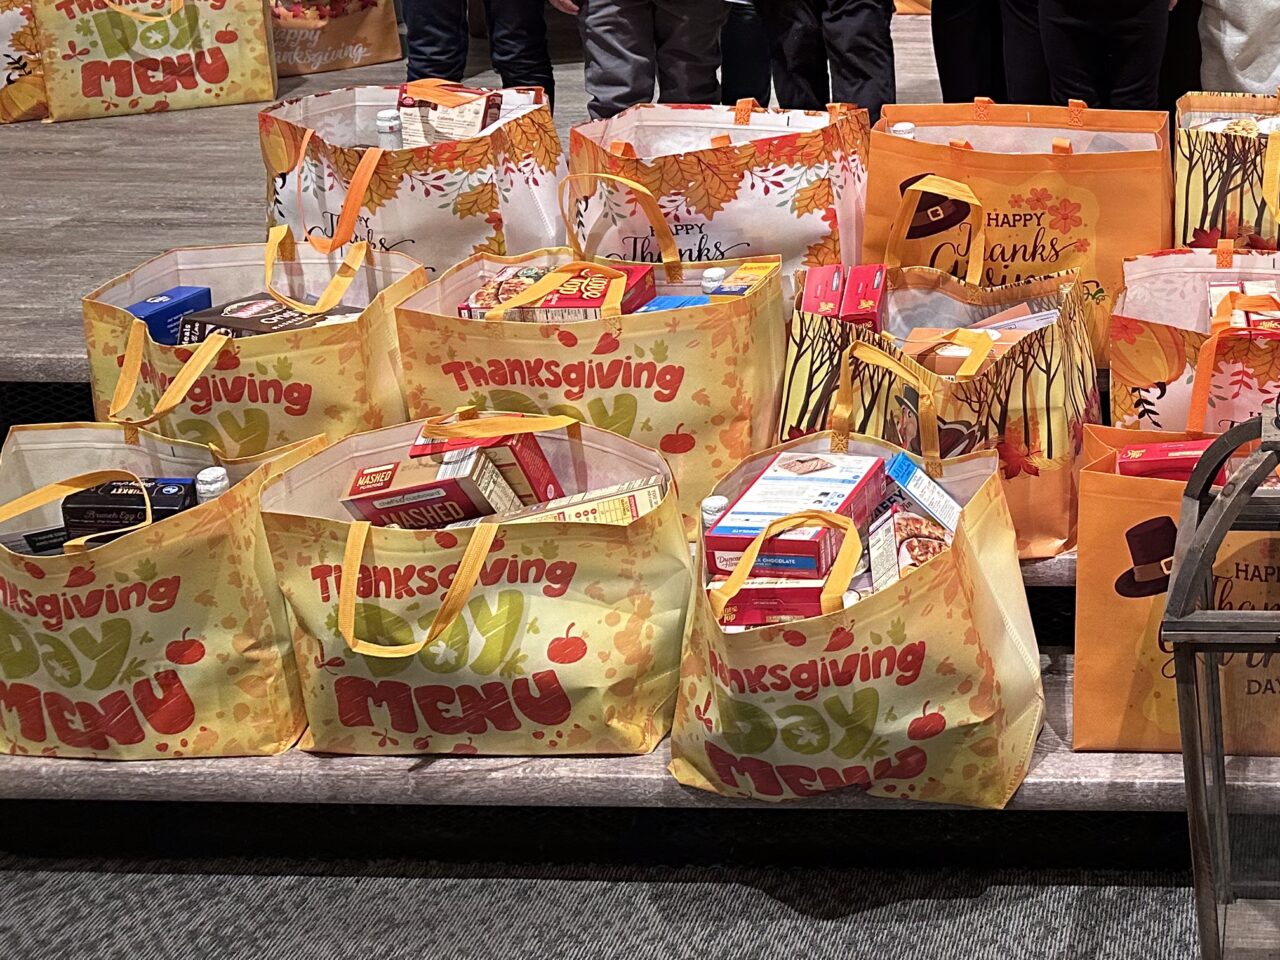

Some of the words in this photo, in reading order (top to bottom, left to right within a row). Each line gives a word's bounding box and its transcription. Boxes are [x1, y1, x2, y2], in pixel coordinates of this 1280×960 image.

[81, 46, 230, 98] MENU
[987, 212, 1045, 228] HAPPY
[441, 355, 685, 402] Thanksgiving
[357, 470, 393, 487] MASHED
[762, 557, 796, 565] CHOCOLATE
[334, 669, 573, 736] MENU
